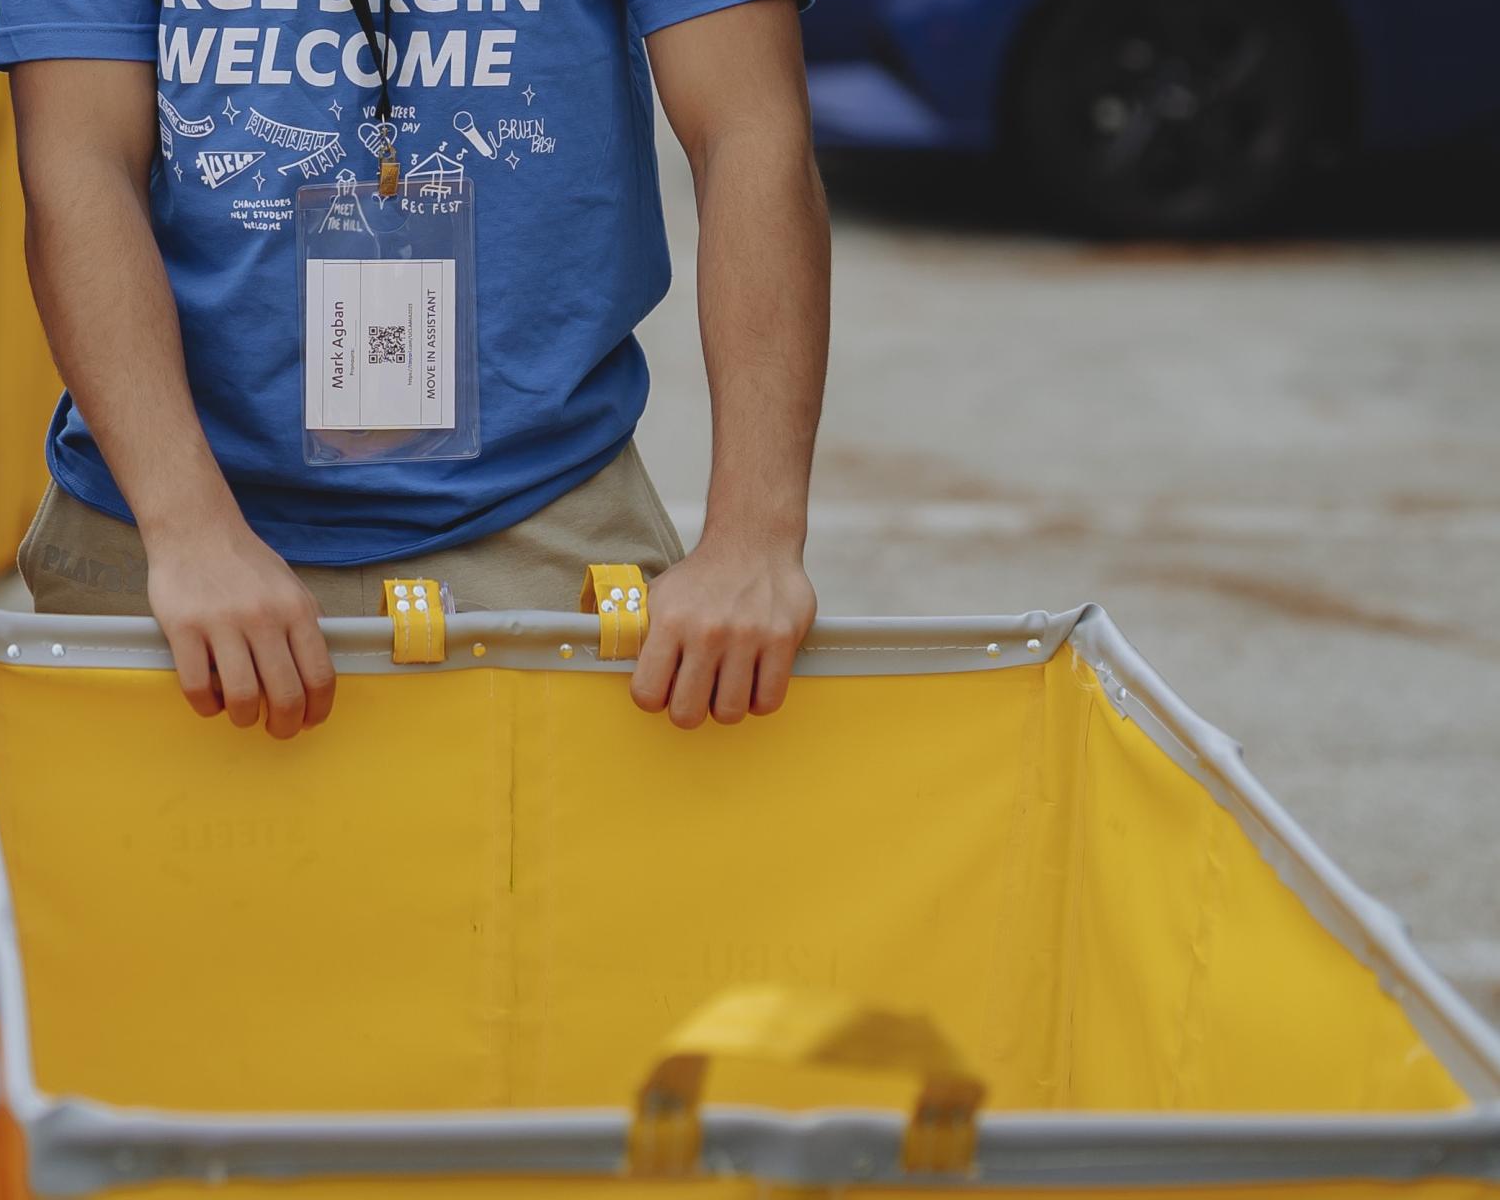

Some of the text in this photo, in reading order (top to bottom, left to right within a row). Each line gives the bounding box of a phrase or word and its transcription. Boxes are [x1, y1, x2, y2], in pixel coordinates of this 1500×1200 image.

[157, 28, 517, 88] WELCOME
[250, 116, 327, 149] SPIRIT
[401, 122, 421, 135] DAY
[498, 118, 545, 148] BRUIN
[531, 135, 556, 154] BASH
[302, 146, 340, 172] DAY
[230, 210, 294, 220] NEW STUDENT
[334, 203, 354, 216] MEET
[401, 199, 462, 215] REC FEST
[243, 221, 281, 231] WELCOME
[328, 216, 363, 232] THE HILL
[330, 300, 348, 390] Mark Agban
[426, 288, 438, 400] MOVE IN ASSISTANT
